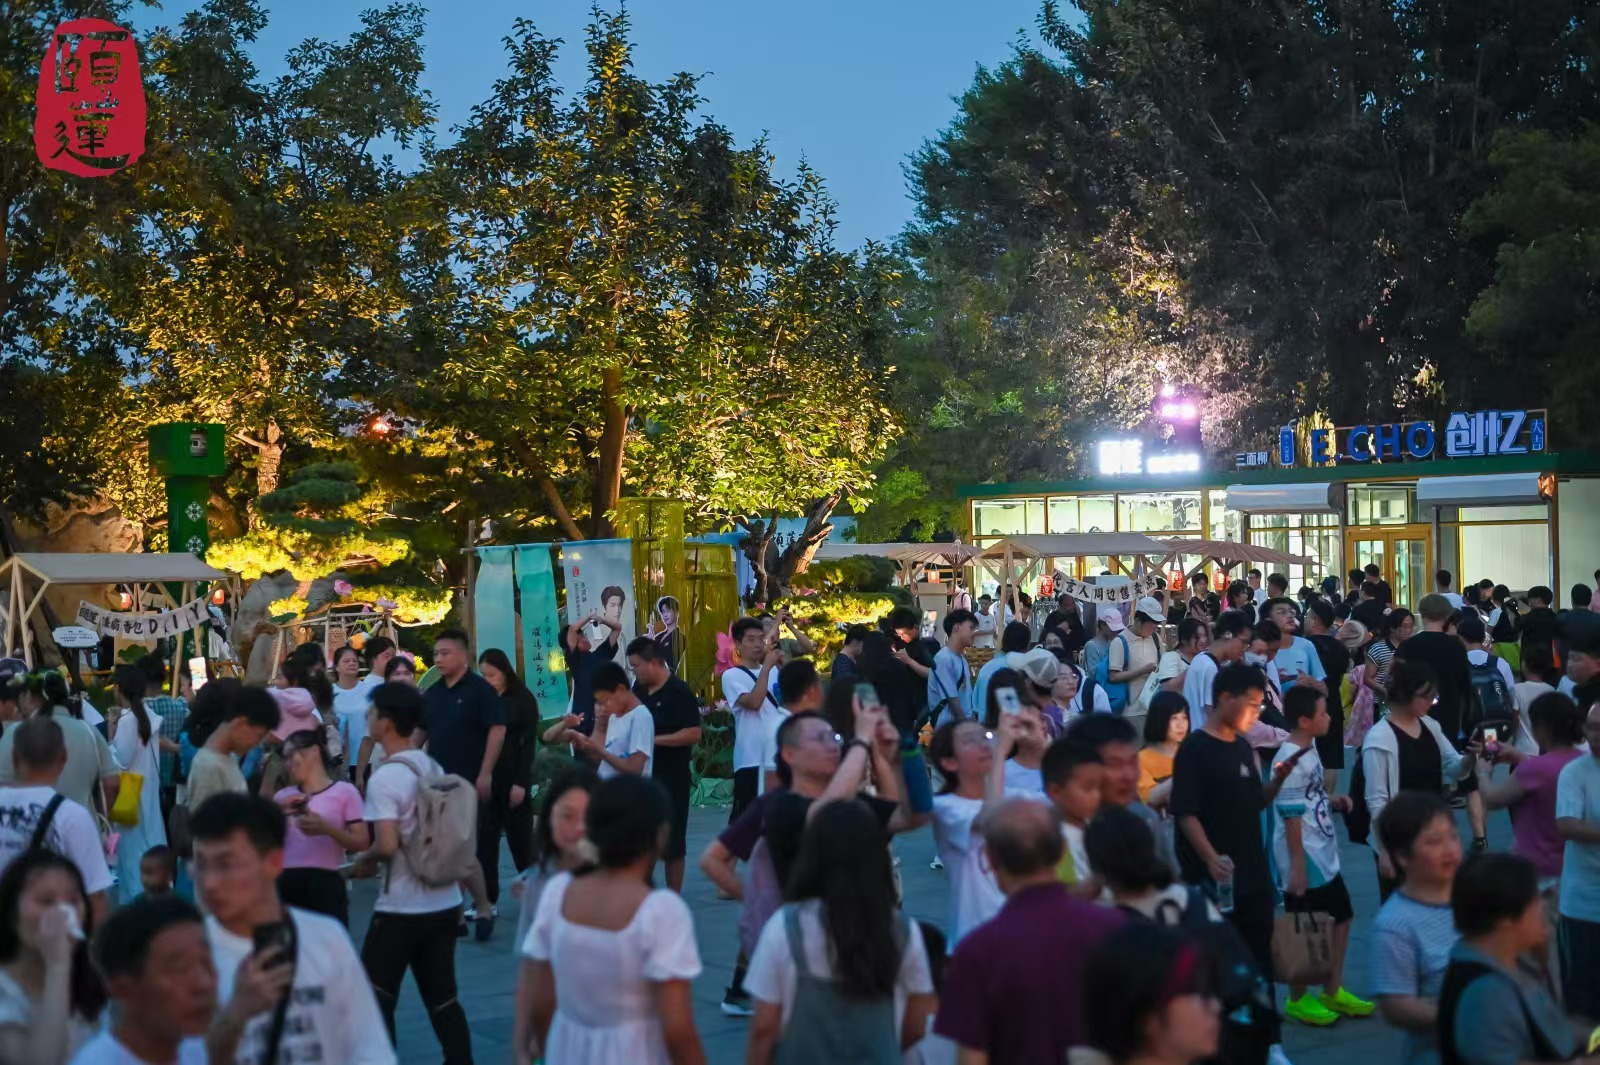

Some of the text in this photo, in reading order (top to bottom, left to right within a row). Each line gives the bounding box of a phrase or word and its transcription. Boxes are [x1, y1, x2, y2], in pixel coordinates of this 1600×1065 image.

[1235, 451, 1268, 466] 三面柳
[1053, 571, 1157, 602] 代言人周边售卖点
